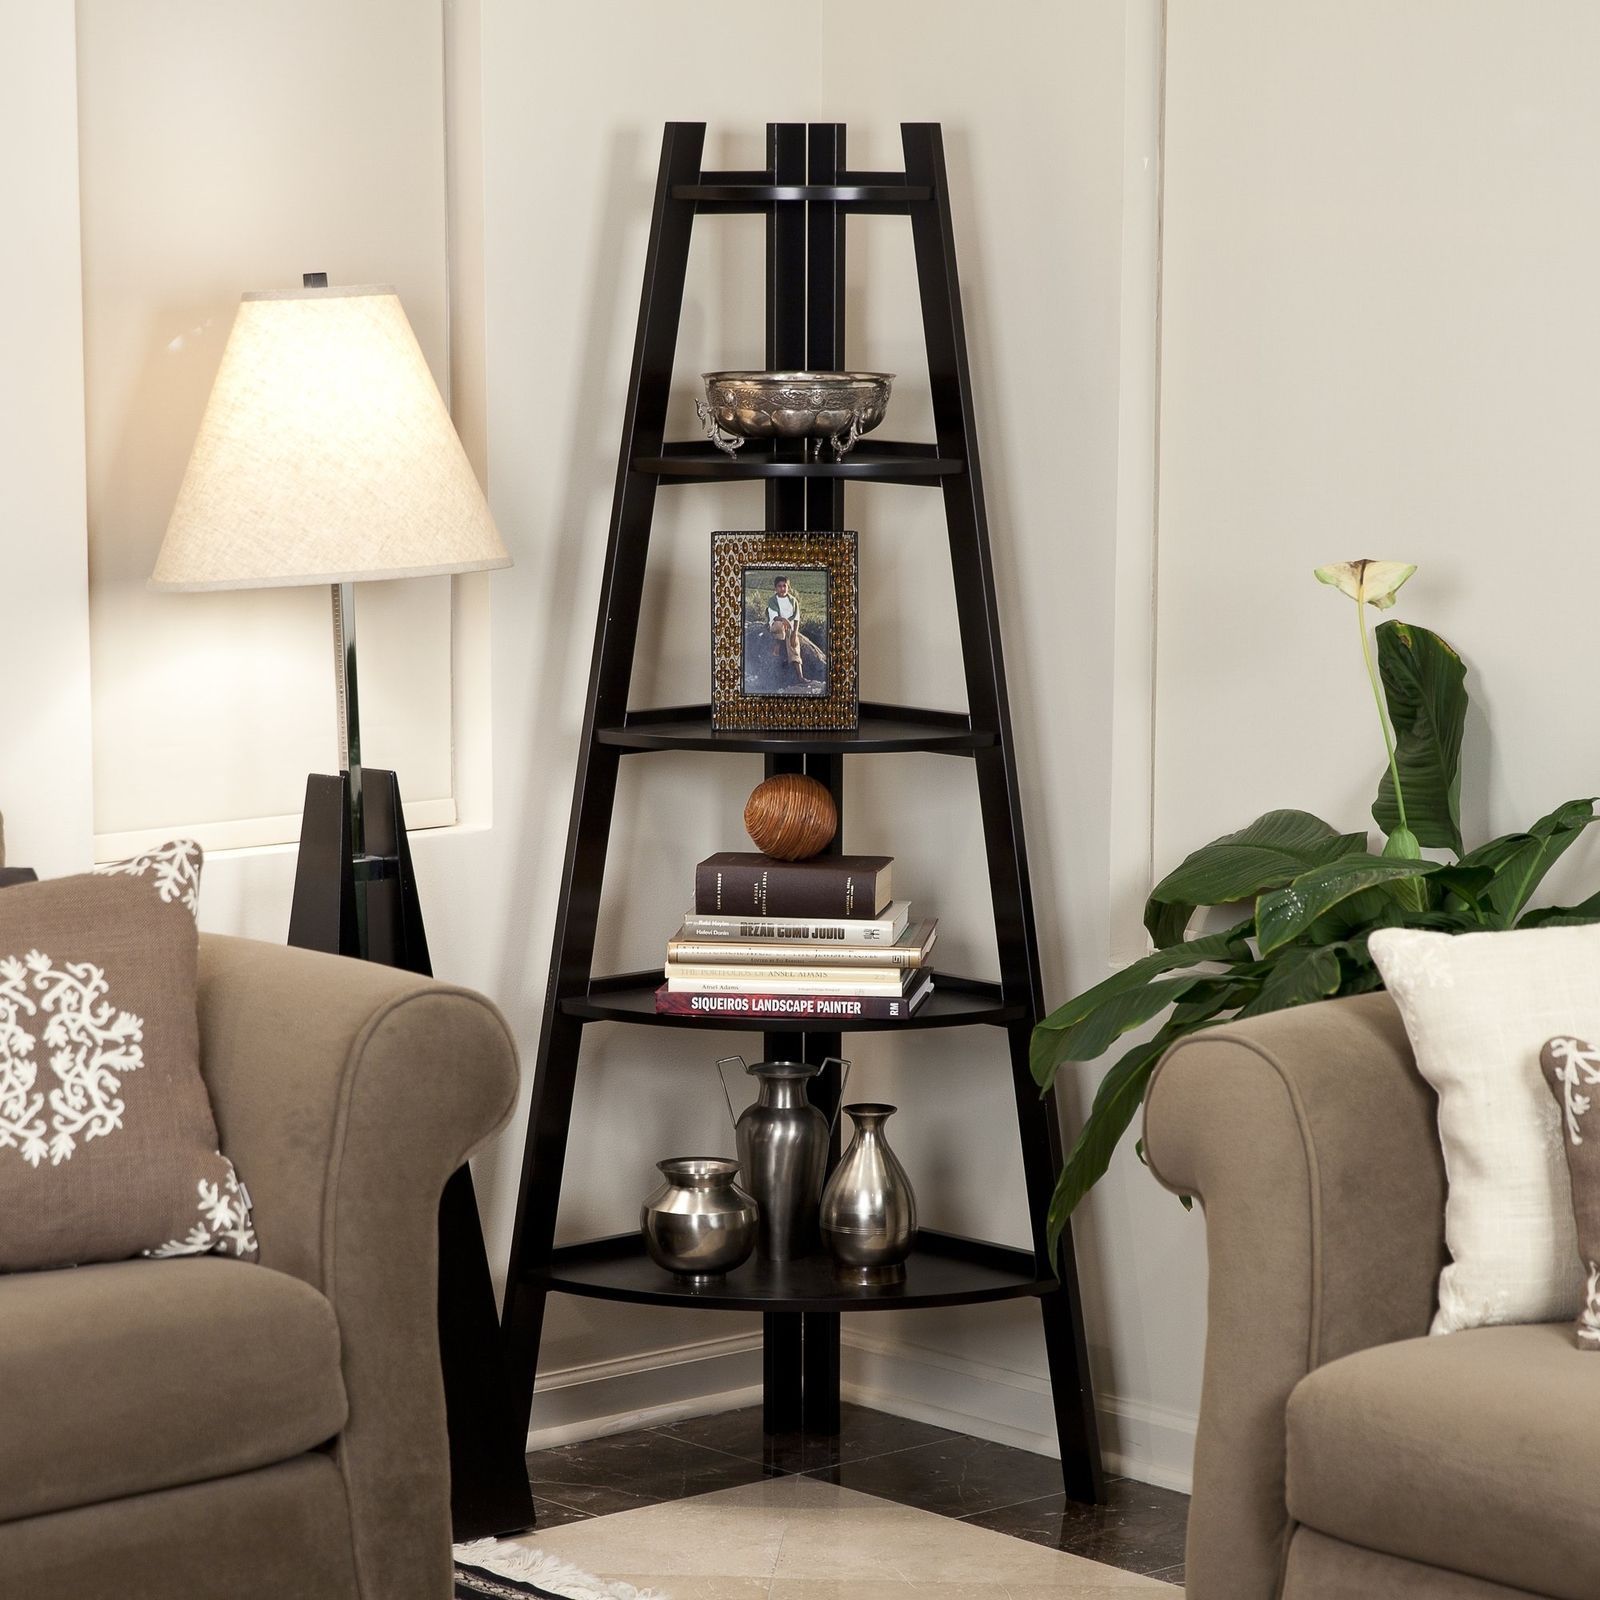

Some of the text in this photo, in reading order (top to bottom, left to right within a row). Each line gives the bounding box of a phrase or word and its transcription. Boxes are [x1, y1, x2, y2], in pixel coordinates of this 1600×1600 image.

[767, 970, 796, 978] ANSEL
[798, 971, 829, 979] ADAMS
[691, 997, 862, 1015] SIQUEIROS LANDSCAPE PAINTER
[889, 1002, 899, 1016] RM
